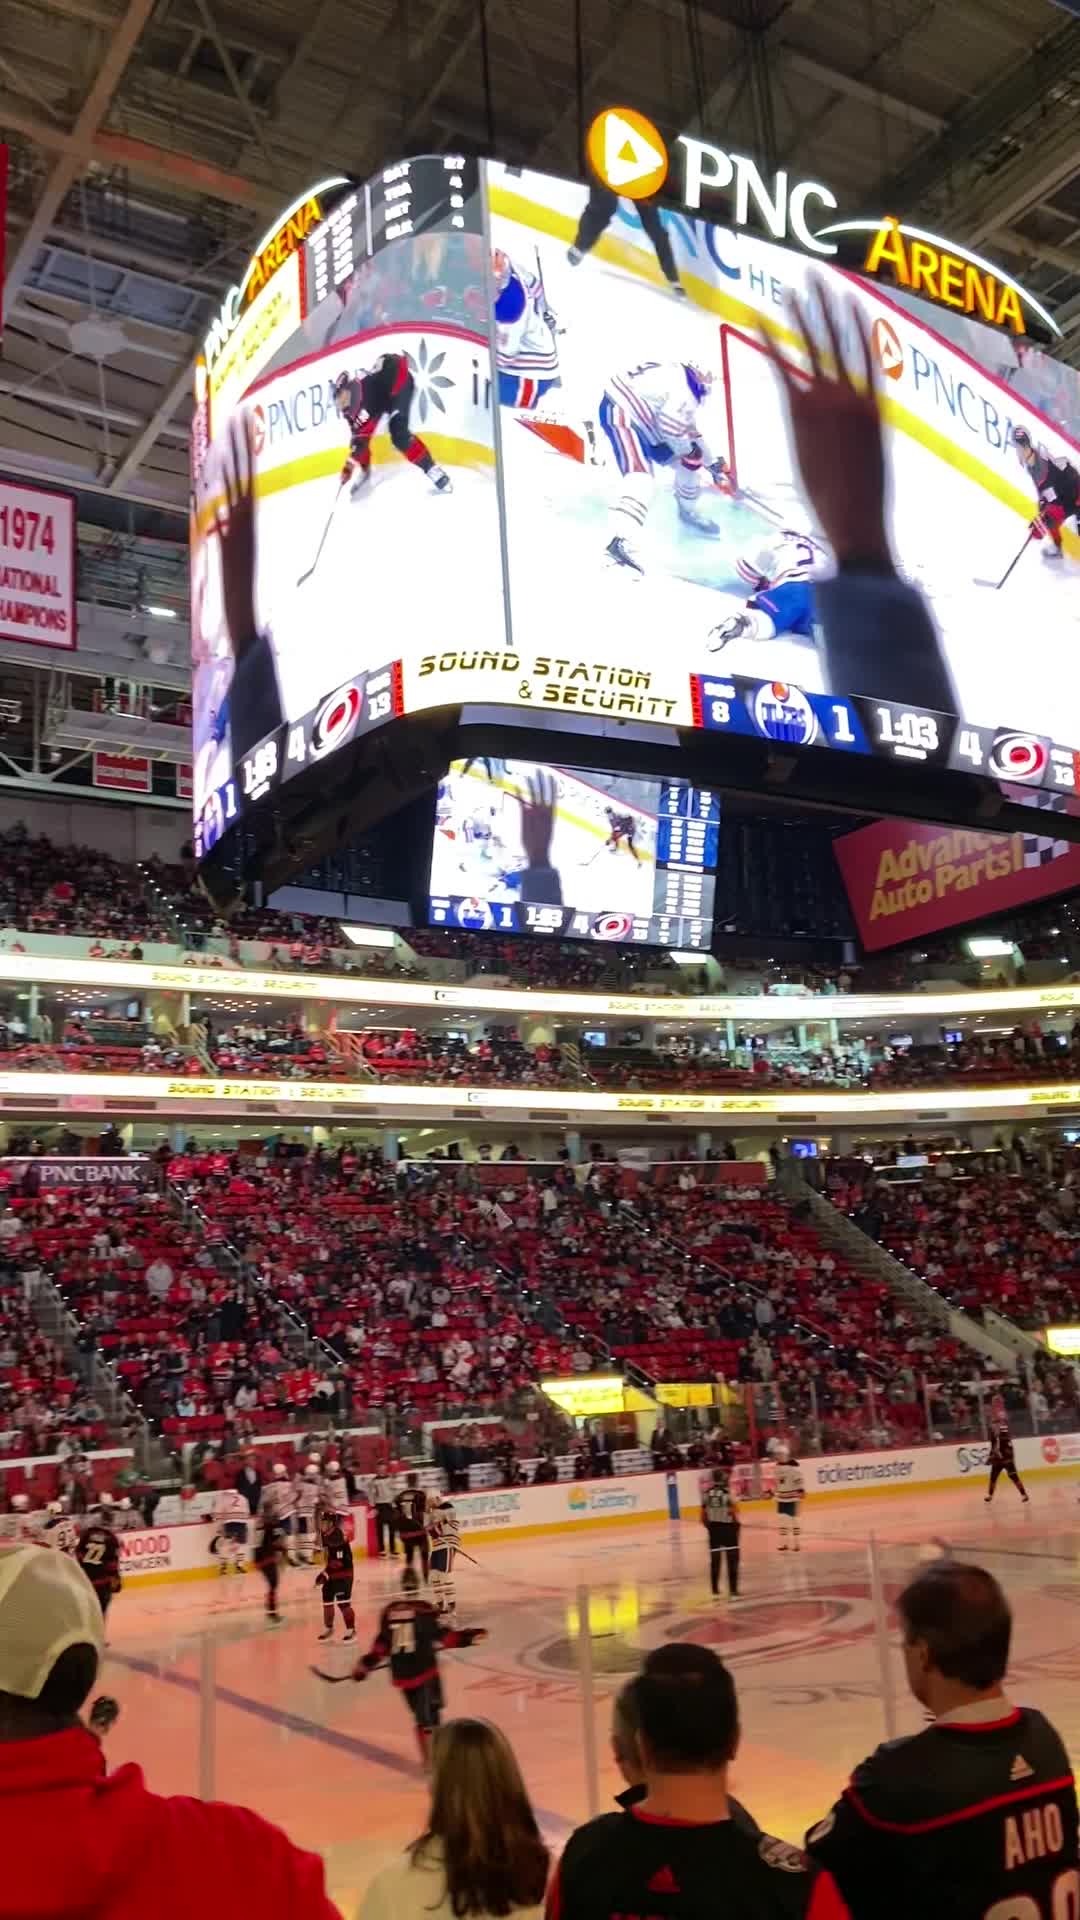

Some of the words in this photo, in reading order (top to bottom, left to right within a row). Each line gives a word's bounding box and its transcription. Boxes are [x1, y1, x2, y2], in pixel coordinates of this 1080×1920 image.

[247, 197, 322, 301] ARENA
[677, 134, 838, 255] PNC
[864, 216, 1026, 335] ARENA
[0, 505, 54, 555] 1974
[418, 651, 521, 677] SOUND
[532, 656, 652, 690] STATION
[518, 679, 533, 700] &
[542, 683, 678, 717] SECURITY
[712, 701, 730, 723] 8
[833, 704, 855, 742] 1
[877, 707, 939, 750] 1:03
[959, 730, 983, 765] 4
[225, 783, 237, 818] 1
[288, 726, 305, 762] 4
[868, 879, 934, 921] Auto
[500, 907, 513, 927] 1
[573, 914, 590, 934] 4
[167, 1083, 216, 1095] SOUND
[223, 1083, 281, 1096] STATION
[39, 1165, 141, 1182] PNCBANK
[816, 1459, 914, 1484] ticketmaster
[1004, 1803, 1064, 1870] AHO
